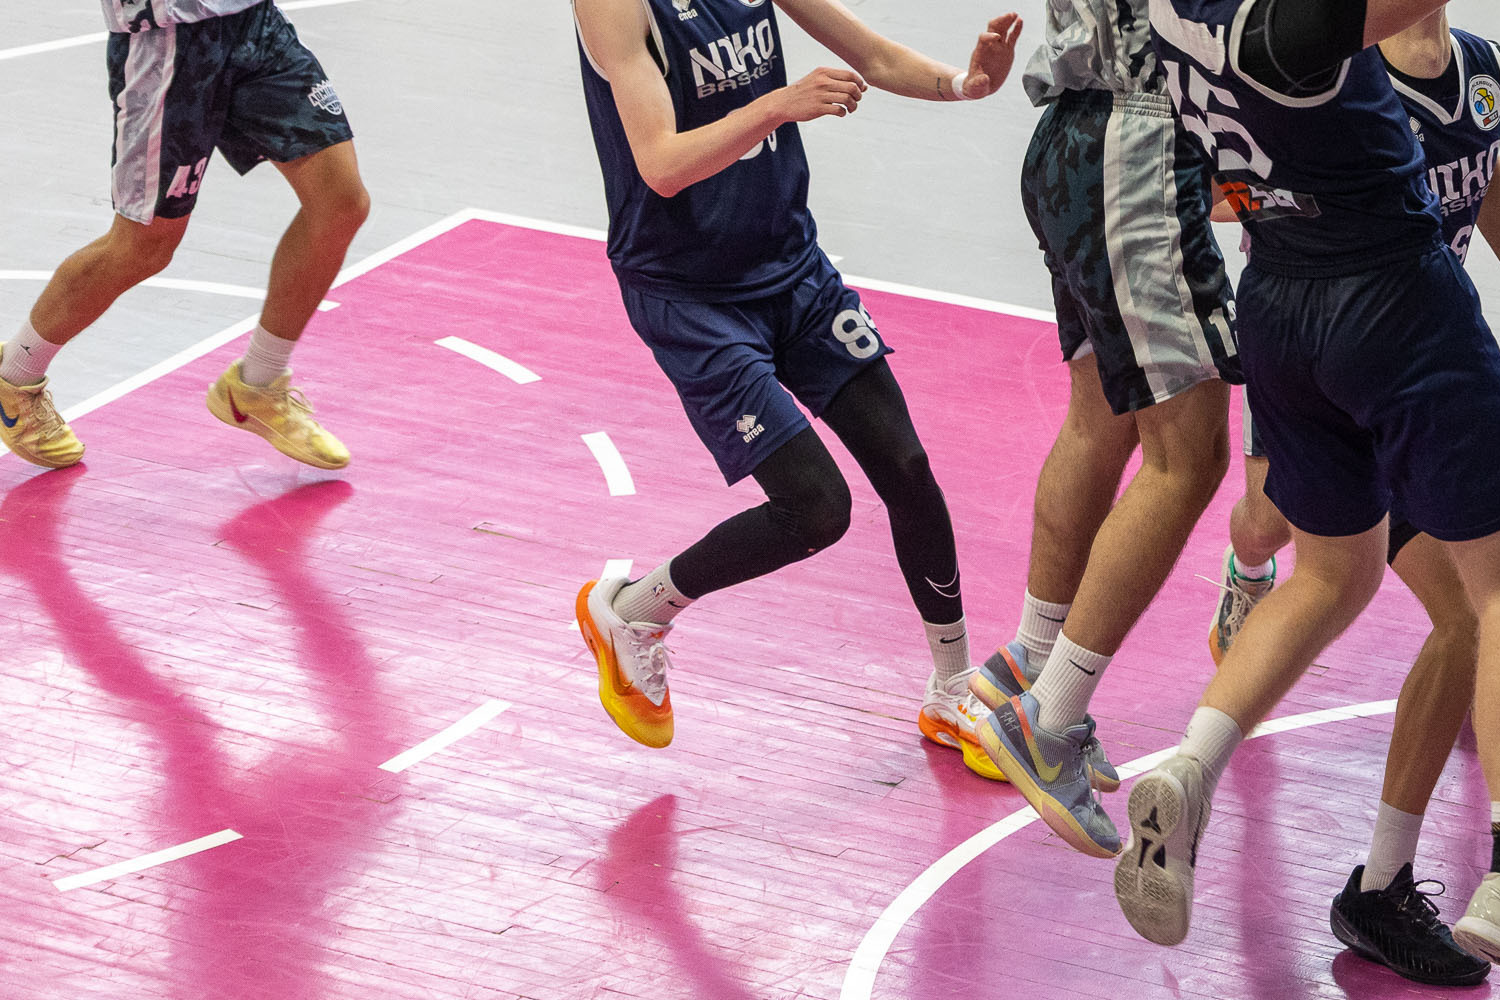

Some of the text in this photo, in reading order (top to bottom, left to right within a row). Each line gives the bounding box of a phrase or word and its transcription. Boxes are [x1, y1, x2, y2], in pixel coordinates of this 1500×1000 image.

[689, 18, 776, 87] NIKO
[697, 55, 778, 100] BASKET
[165, 156, 208, 199] 43
[742, 423, 765, 443] errea
